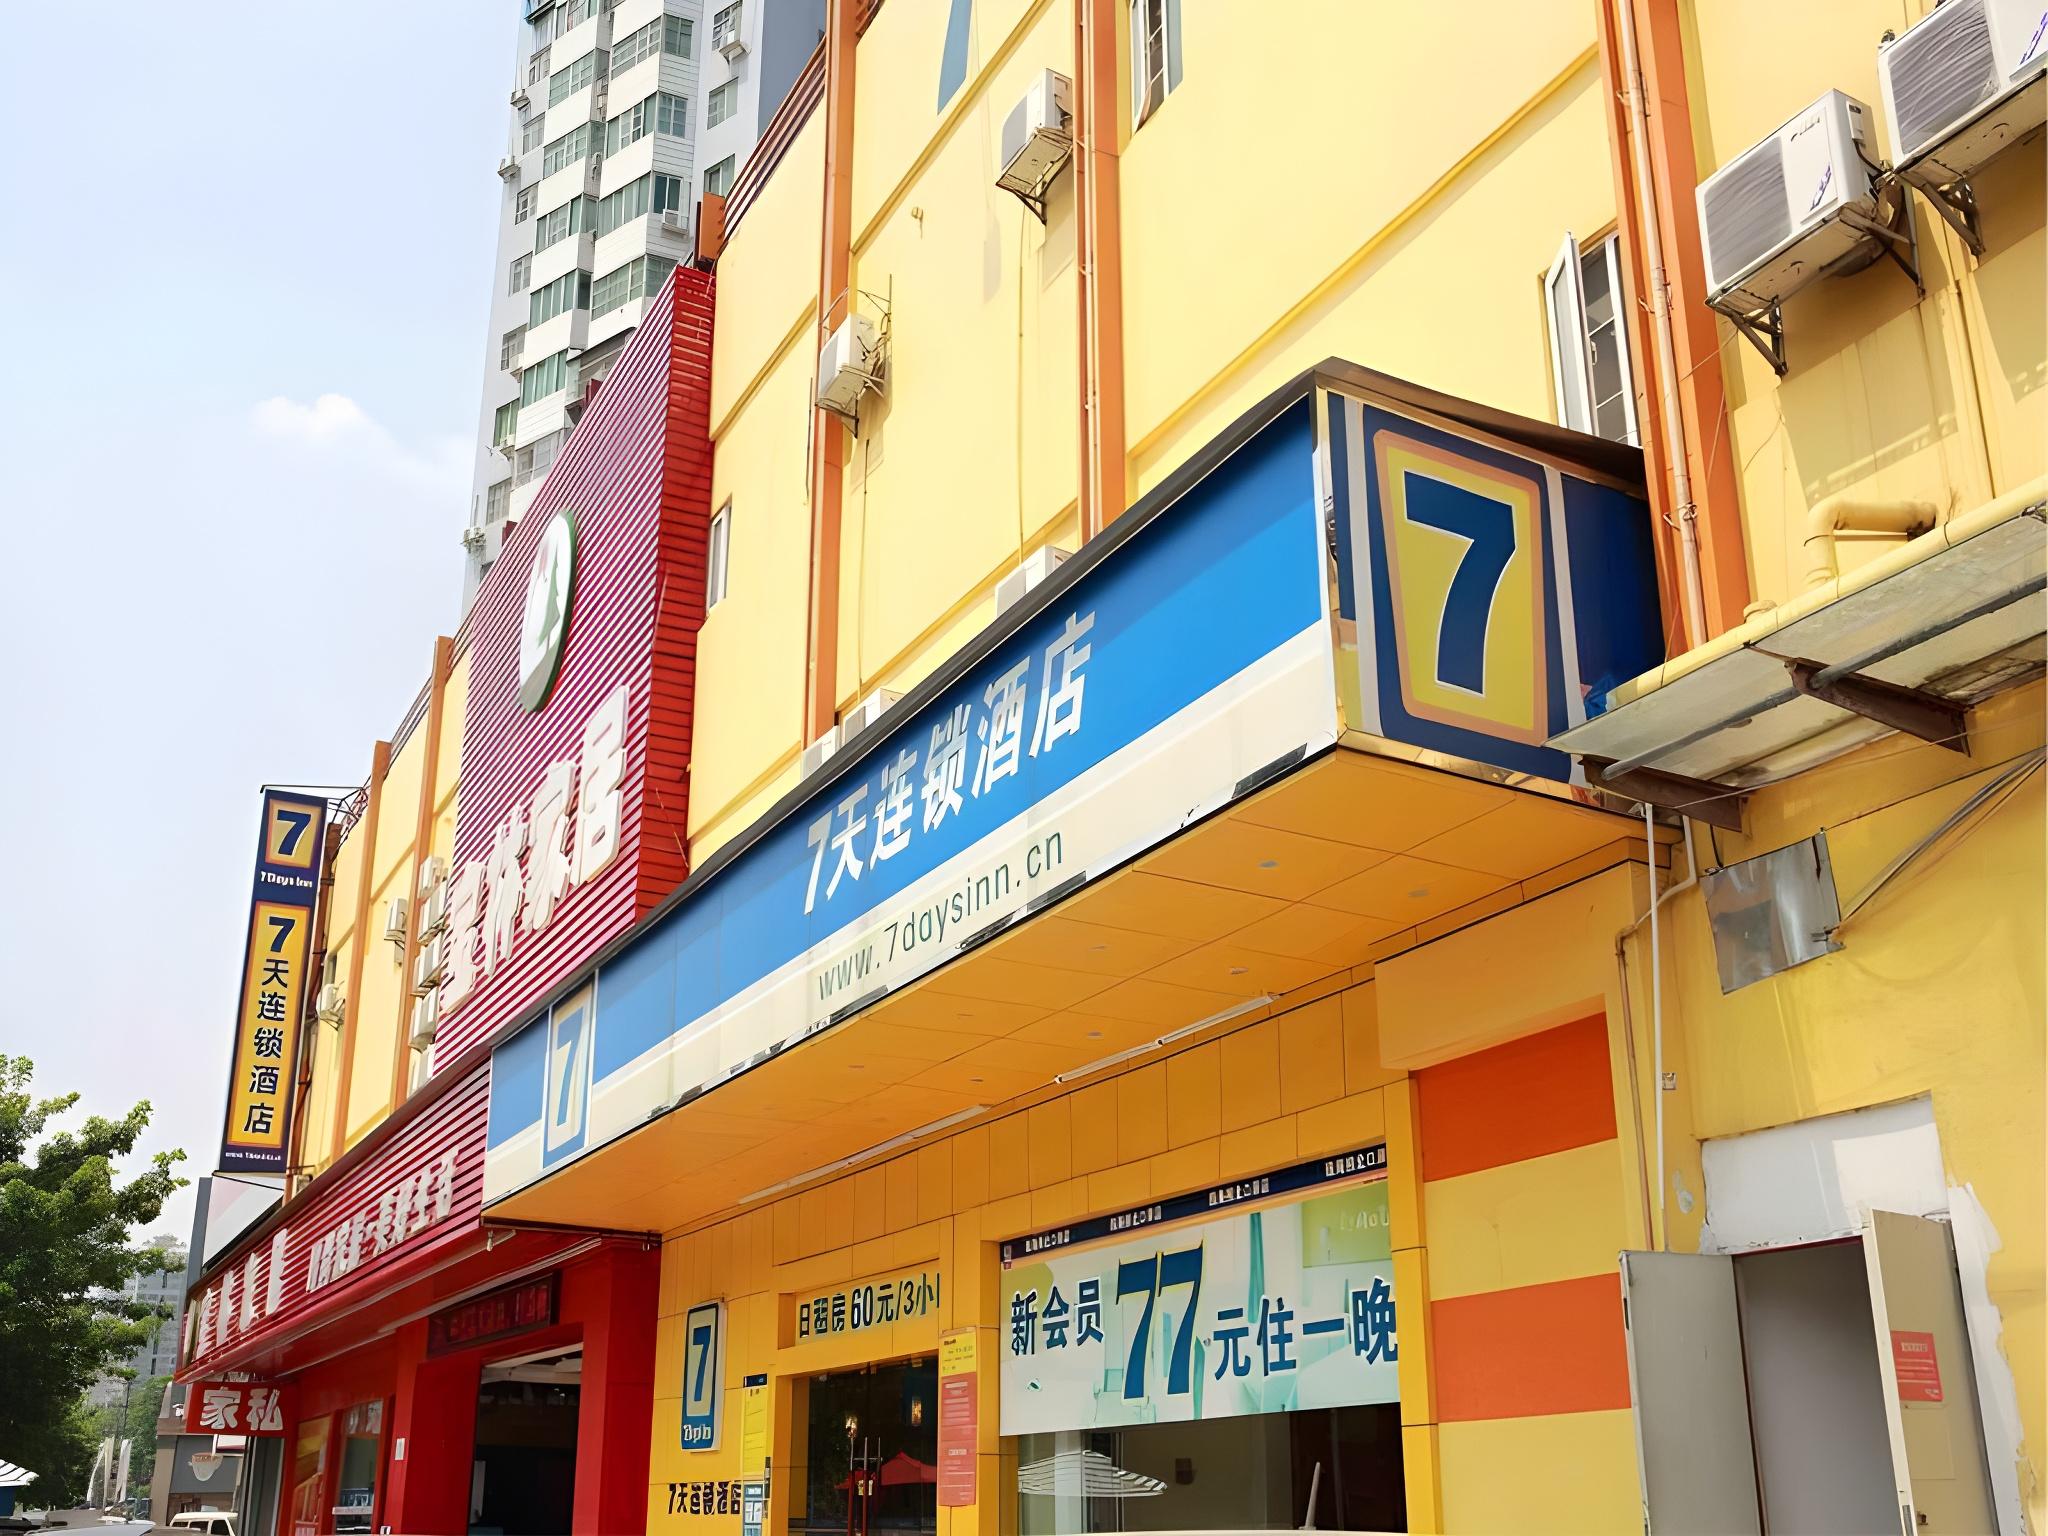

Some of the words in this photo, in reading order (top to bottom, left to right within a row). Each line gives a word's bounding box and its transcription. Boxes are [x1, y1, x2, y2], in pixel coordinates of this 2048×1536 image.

[1402, 468, 1516, 698] 7
[276, 808, 312, 856] 7
[804, 610, 1096, 916] 7天连锁酒店
[818, 830, 1063, 1001] www.7daysinn.cn
[243, 915, 296, 1134] 7天连锁酒店
[556, 1006, 584, 1128] 7
[692, 1325, 711, 1402] 7
[1010, 1238, 1399, 1401] 新会员77元住一晚
[200, 1386, 284, 1431] 家私
